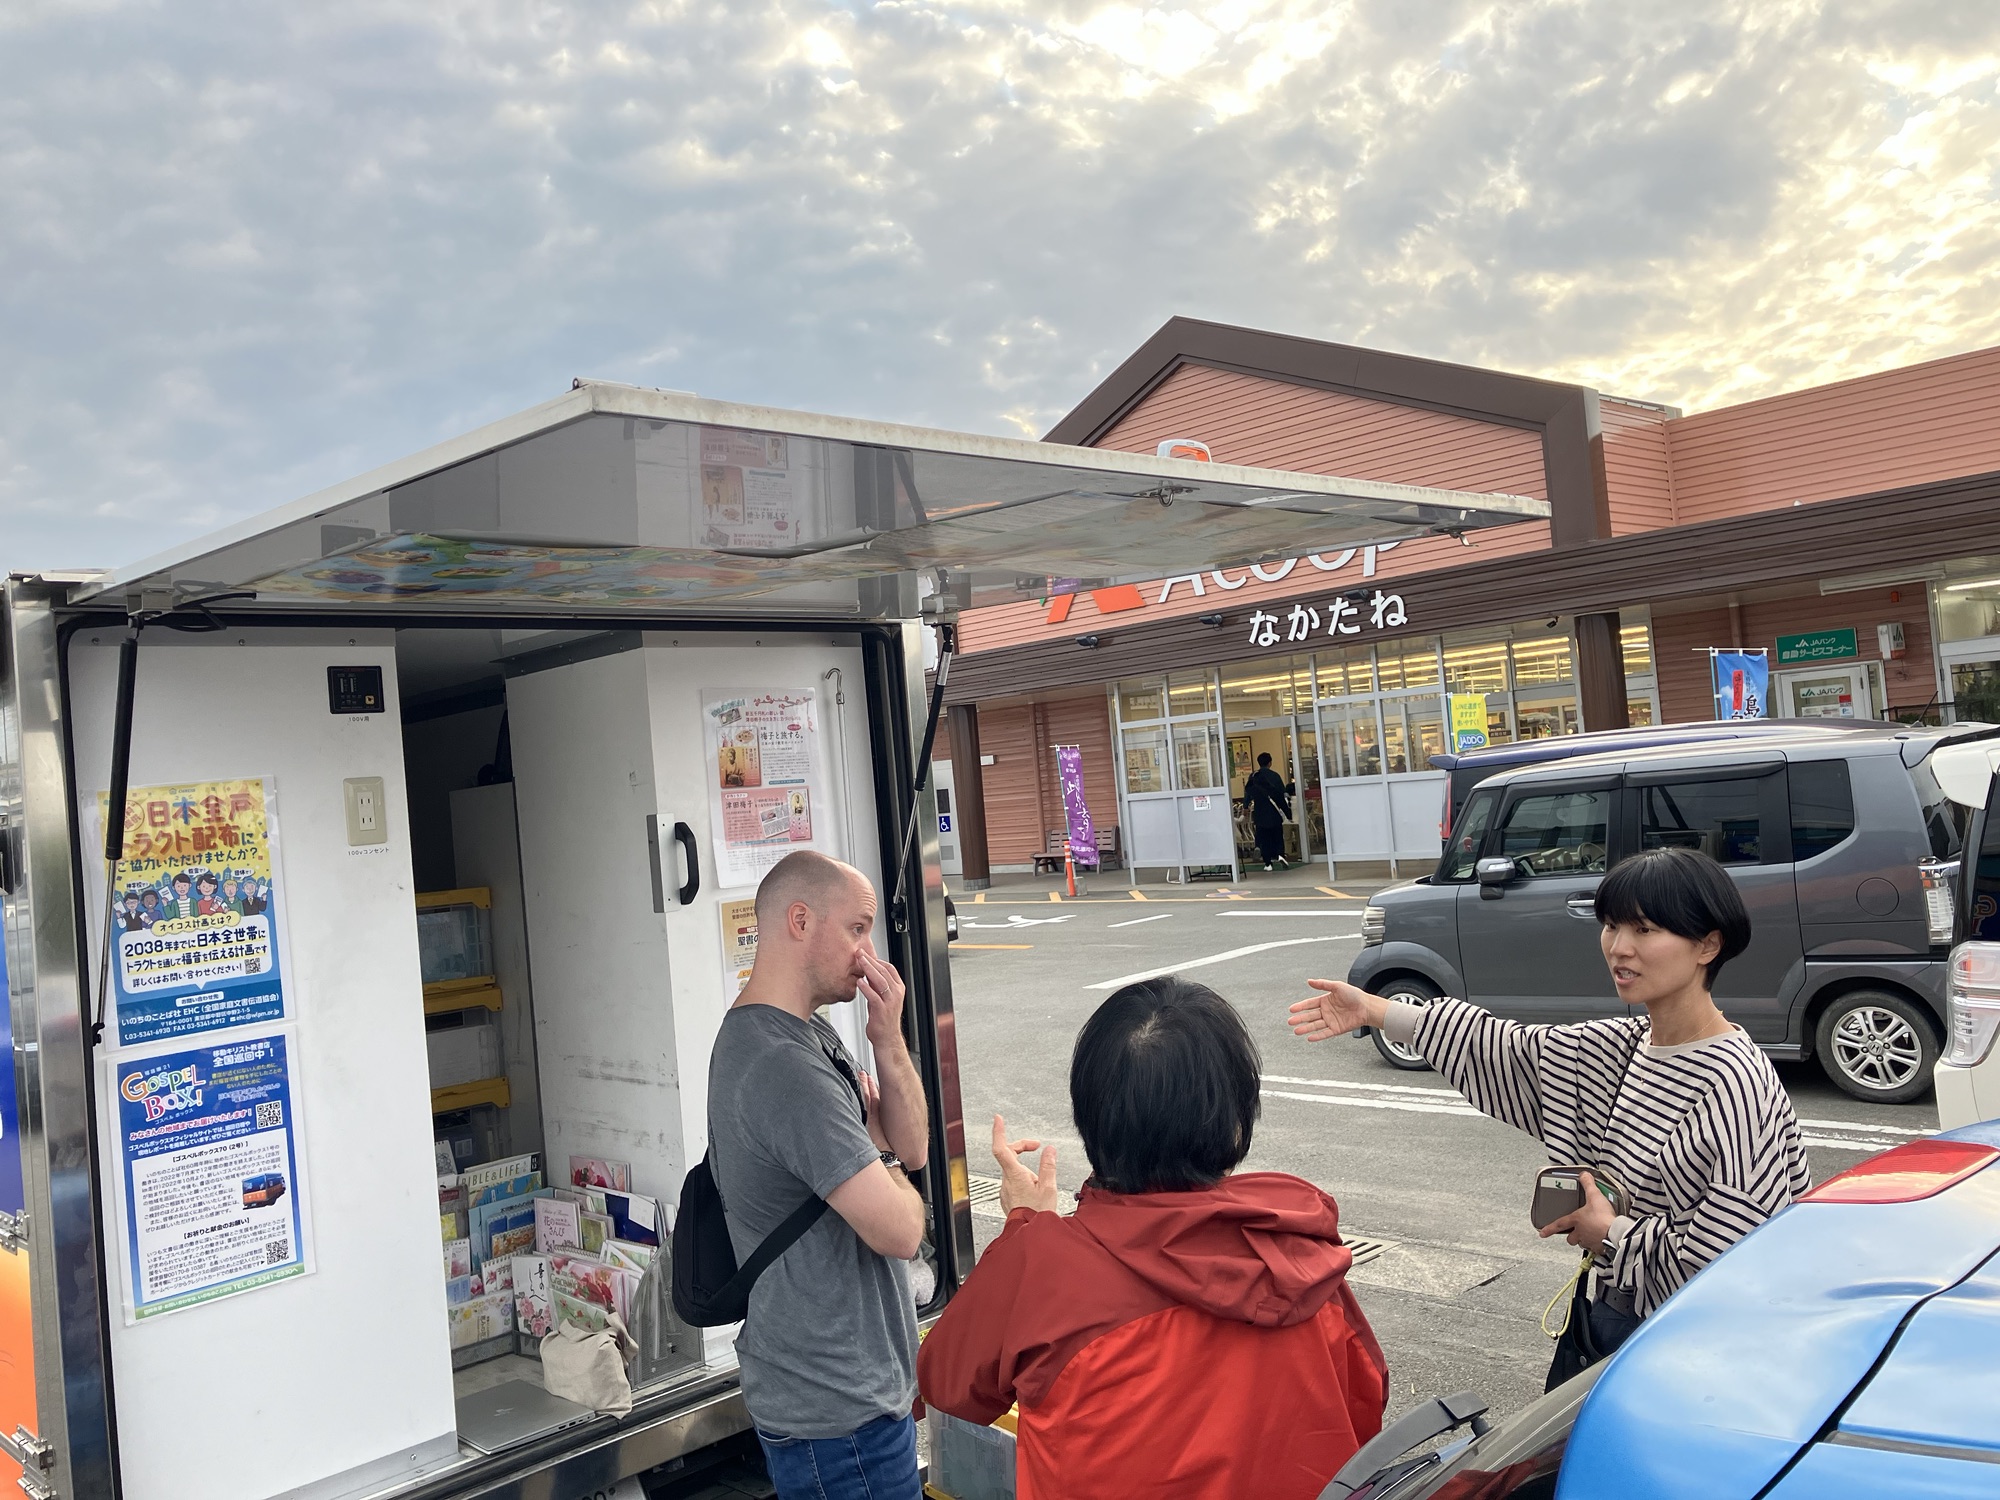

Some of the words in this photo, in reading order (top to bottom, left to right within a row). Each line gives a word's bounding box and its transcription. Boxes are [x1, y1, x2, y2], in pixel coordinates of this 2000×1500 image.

[1249, 589, 1408, 647] なかたね
[1810, 637, 1836, 647] JAバンク
[1817, 687, 1844, 696] JAバンク
[1457, 735, 1484, 748] JADDO
[146, 793, 254, 827] 日本全戸
[122, 823, 255, 856] ラクト配布に
[159, 915, 232, 932] オイコス計画とは？
[124, 925, 267, 957] 2038年までに日本全世帯に
[126, 944, 268, 973] トラクトを通して福音を伝える計画です
[183, 1006, 200, 1015] EHC
[173, 1023, 186, 1033] FAX
[212, 1049, 275, 1068] 全国巡回中！
